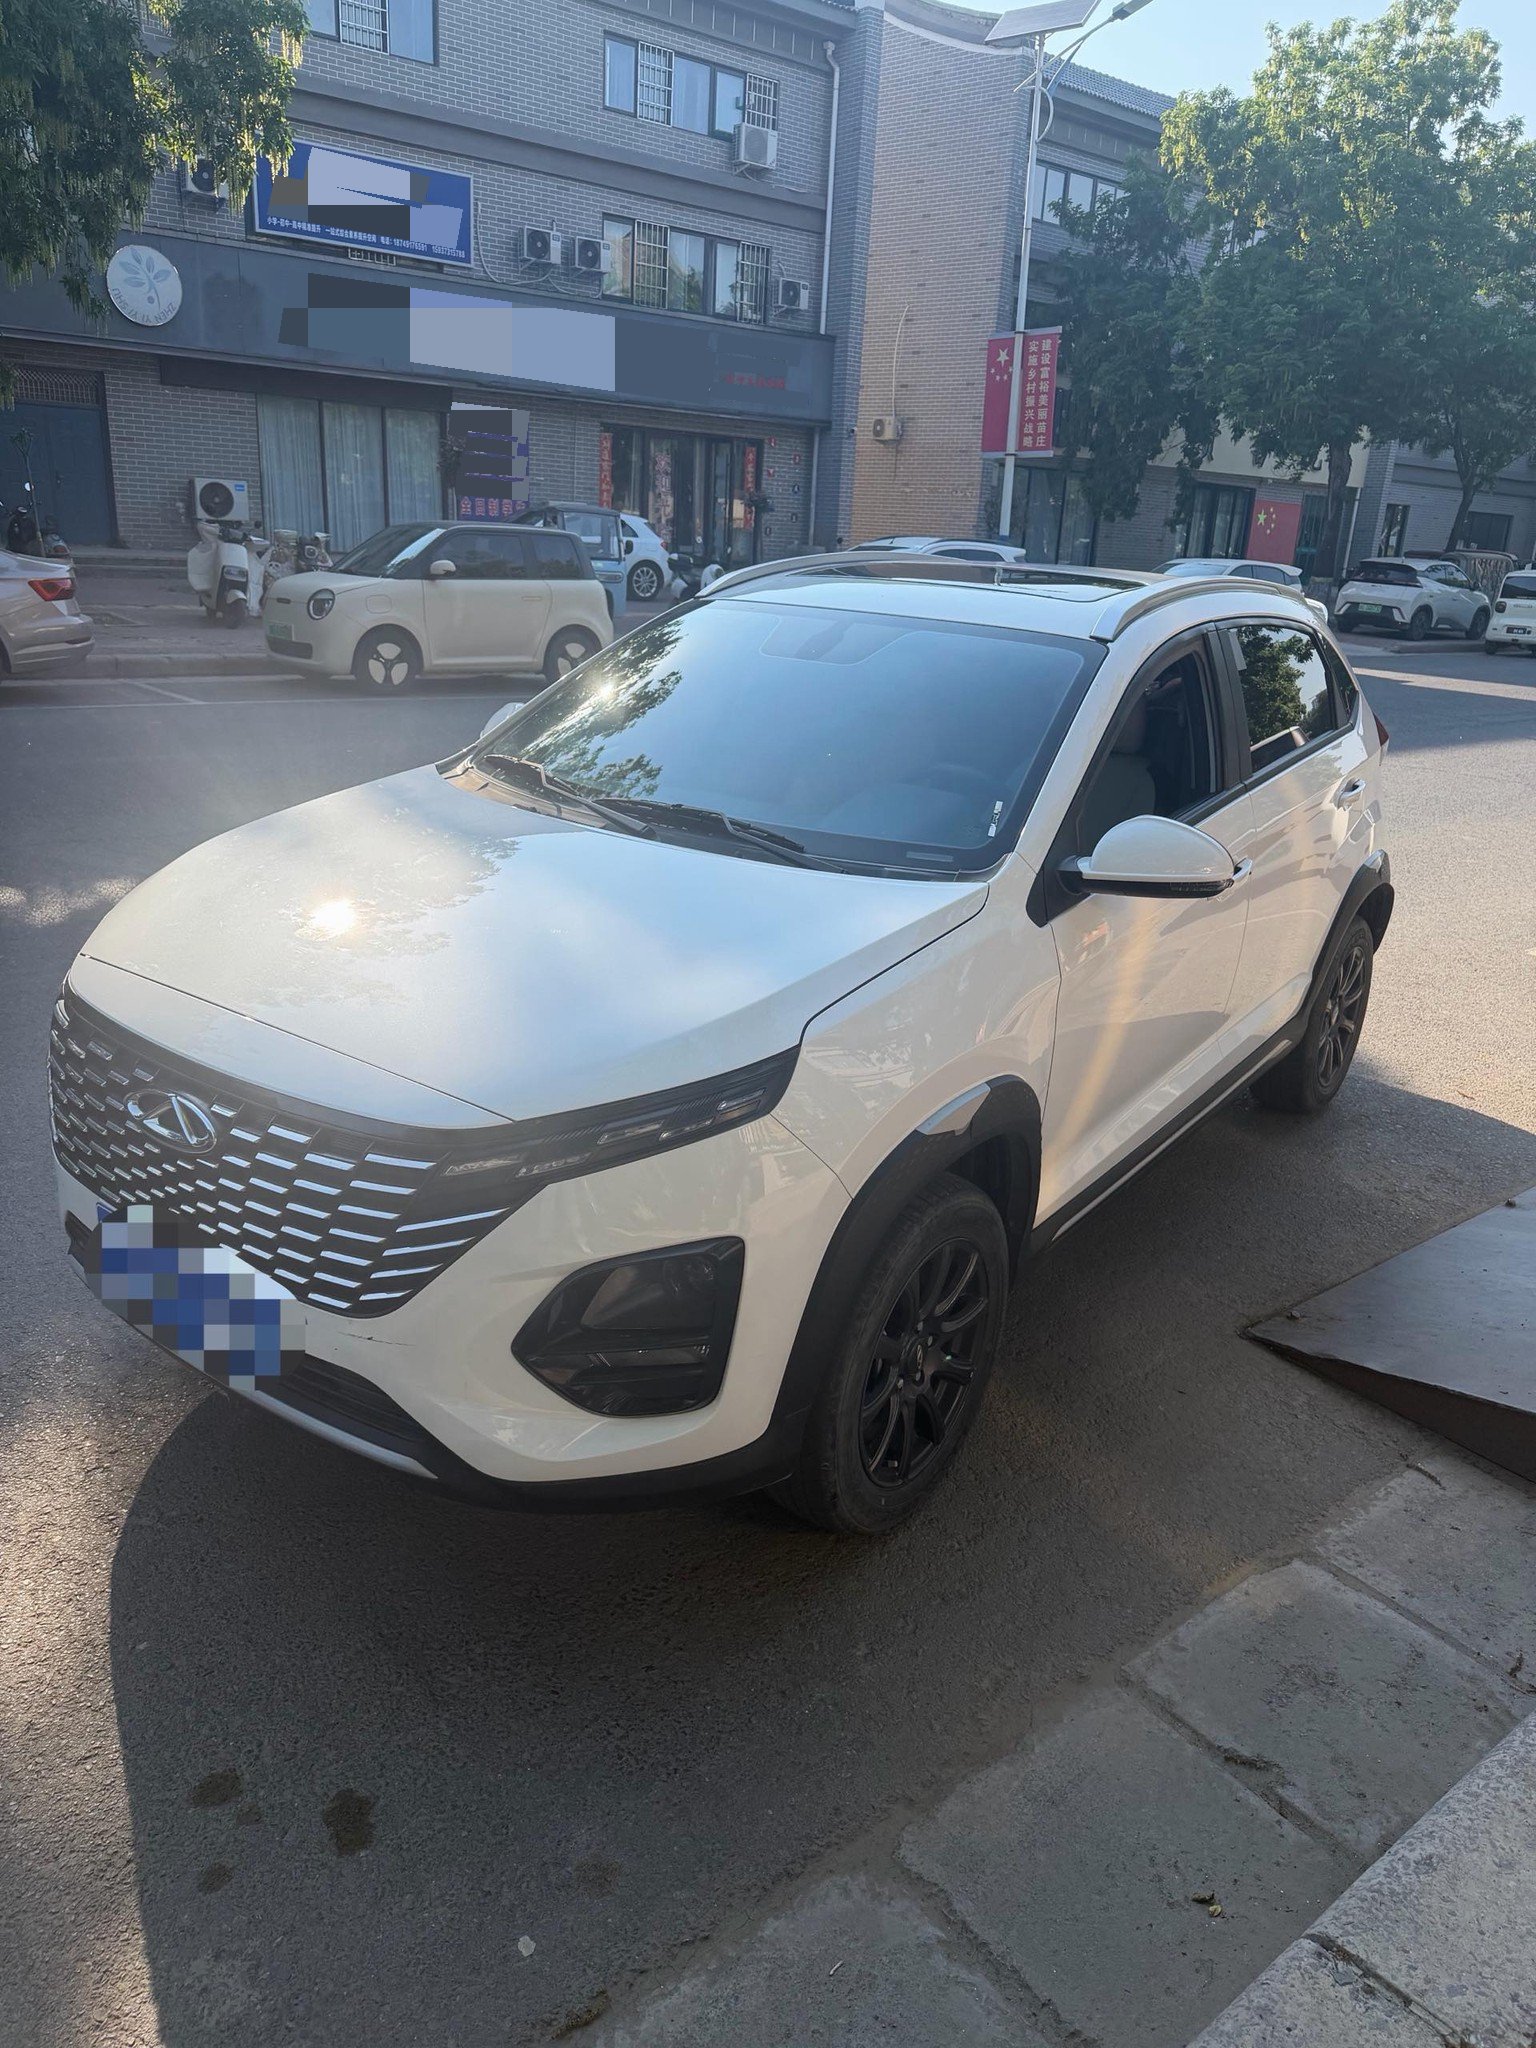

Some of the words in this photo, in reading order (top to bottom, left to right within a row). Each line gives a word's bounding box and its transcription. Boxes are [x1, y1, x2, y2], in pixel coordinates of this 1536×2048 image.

[1022, 340, 1038, 447] 实施乡村振兴战略
[1036, 339, 1052, 447] 建设富裕美丽苗庄
